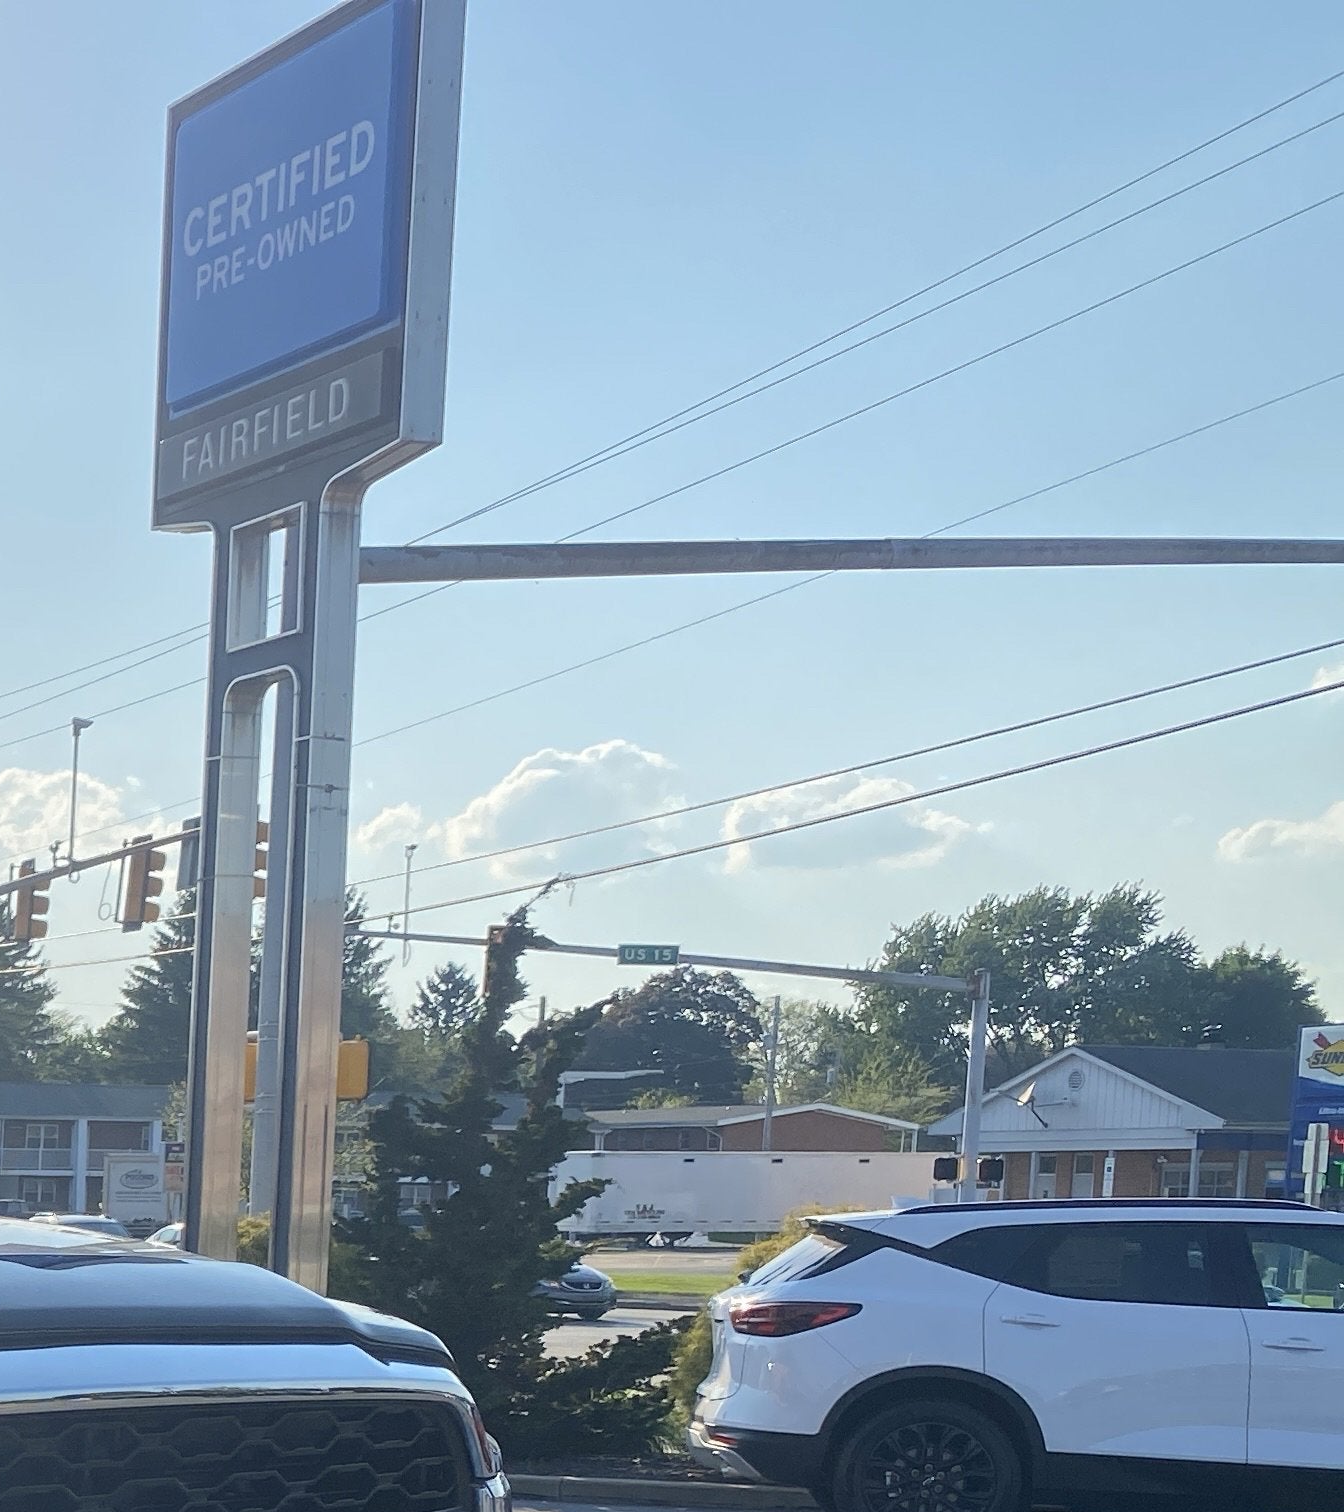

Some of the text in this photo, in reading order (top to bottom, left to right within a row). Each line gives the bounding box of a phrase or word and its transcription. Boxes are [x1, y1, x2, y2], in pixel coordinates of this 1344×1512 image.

[184, 120, 375, 256] CERTIFIED
[196, 194, 355, 300] PRE-OWNED
[182, 378, 349, 479] FAIRFIELD
[624, 948, 672, 961] US 15
[1311, 1051, 1344, 1066] SUN
